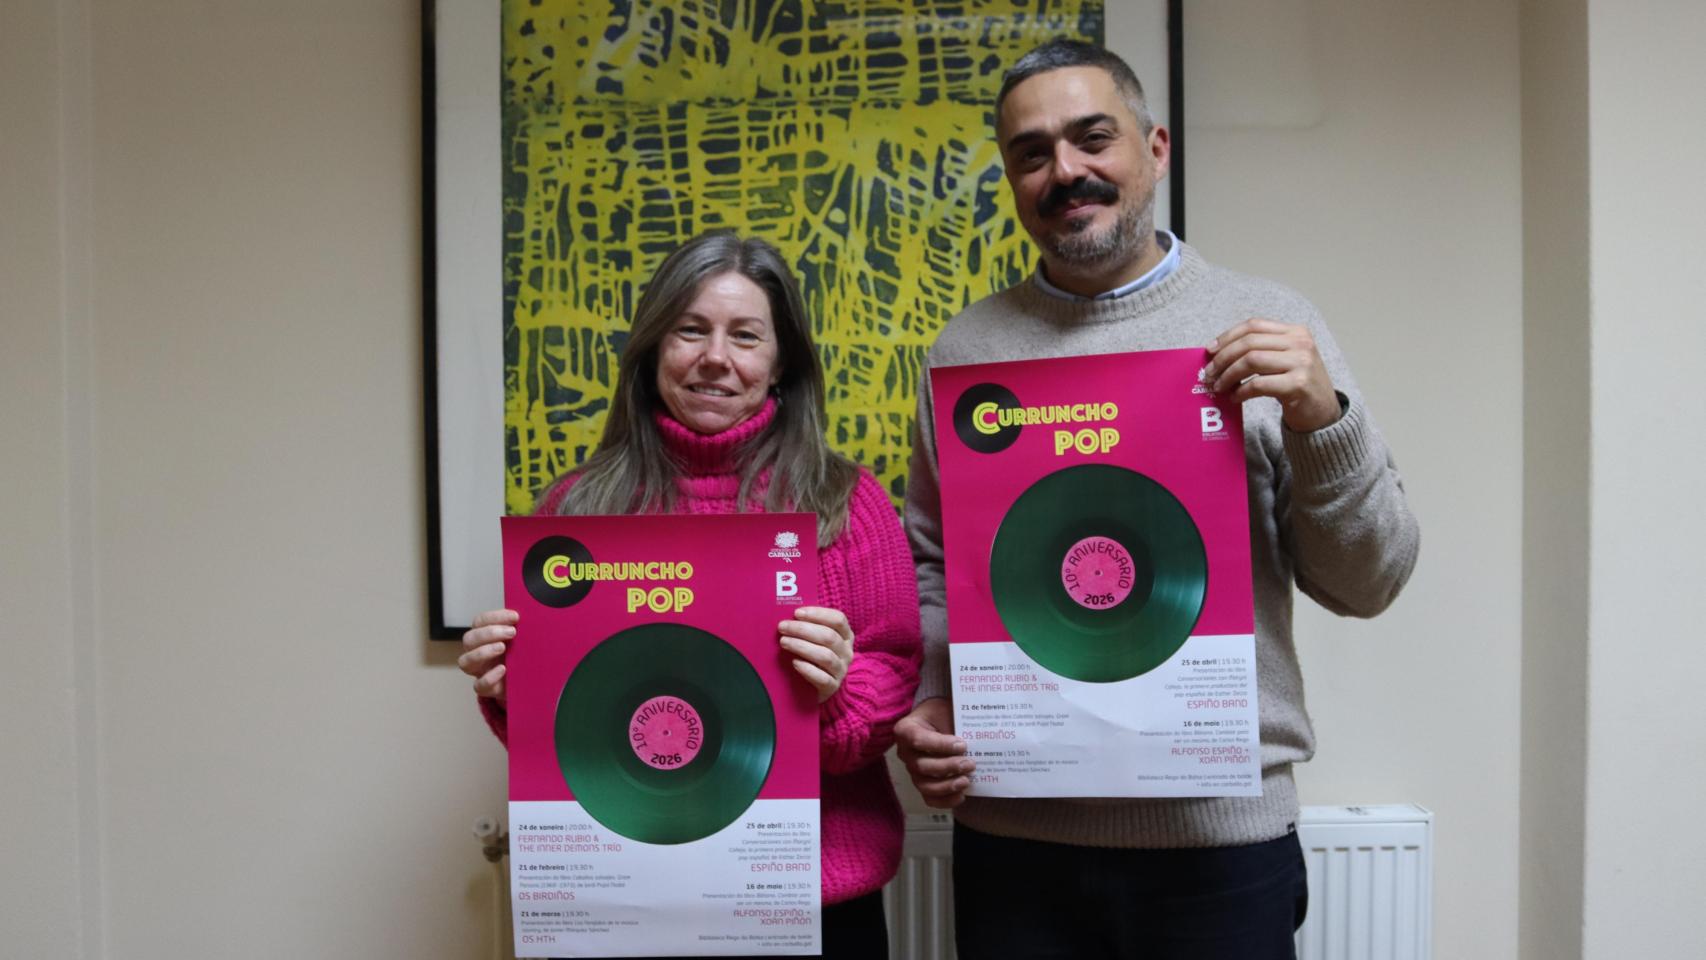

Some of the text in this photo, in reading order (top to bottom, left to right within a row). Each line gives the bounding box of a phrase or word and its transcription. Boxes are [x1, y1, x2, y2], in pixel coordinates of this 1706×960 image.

[1200, 406, 1224, 433] B
[1054, 428, 1120, 456] POP
[1069, 541, 1131, 590] ANIVERSARIO
[776, 571, 798, 597] B
[627, 587, 694, 613] POP
[1084, 592, 1115, 605] 2026
[1182, 658, 1190, 666] 25
[1192, 658, 1200, 666] de
[1202, 658, 1217, 666] abril
[960, 674, 1038, 683] FERNANDO RUBIO &
[960, 684, 976, 693] THE
[978, 684, 1001, 693] INNER
[1004, 684, 1038, 692] DEMONS
[1187, 699, 1248, 709] ESPIÑO BAND
[637, 701, 699, 750] ANIVERSARIO
[963, 730, 1016, 740] OS BIRDIÑOS
[1172, 747, 1210, 756] ALFONSO
[1212, 746, 1242, 755] ESPIÑO
[651, 753, 682, 765] 2026
[980, 775, 999, 784] HTH
[518, 835, 599, 843] FERNANDO RUBIO &
[519, 844, 535, 853] THE
[537, 844, 561, 853] INNER
[564, 844, 600, 853] DEMONS
[751, 862, 811, 872] ESPIÑO BAND
[518, 890, 575, 901] OS BIRDIÑOS
[734, 909, 772, 917] ALFONSO
[774, 908, 803, 917] ESPIÑO
[522, 935, 556, 944] OS HTH
